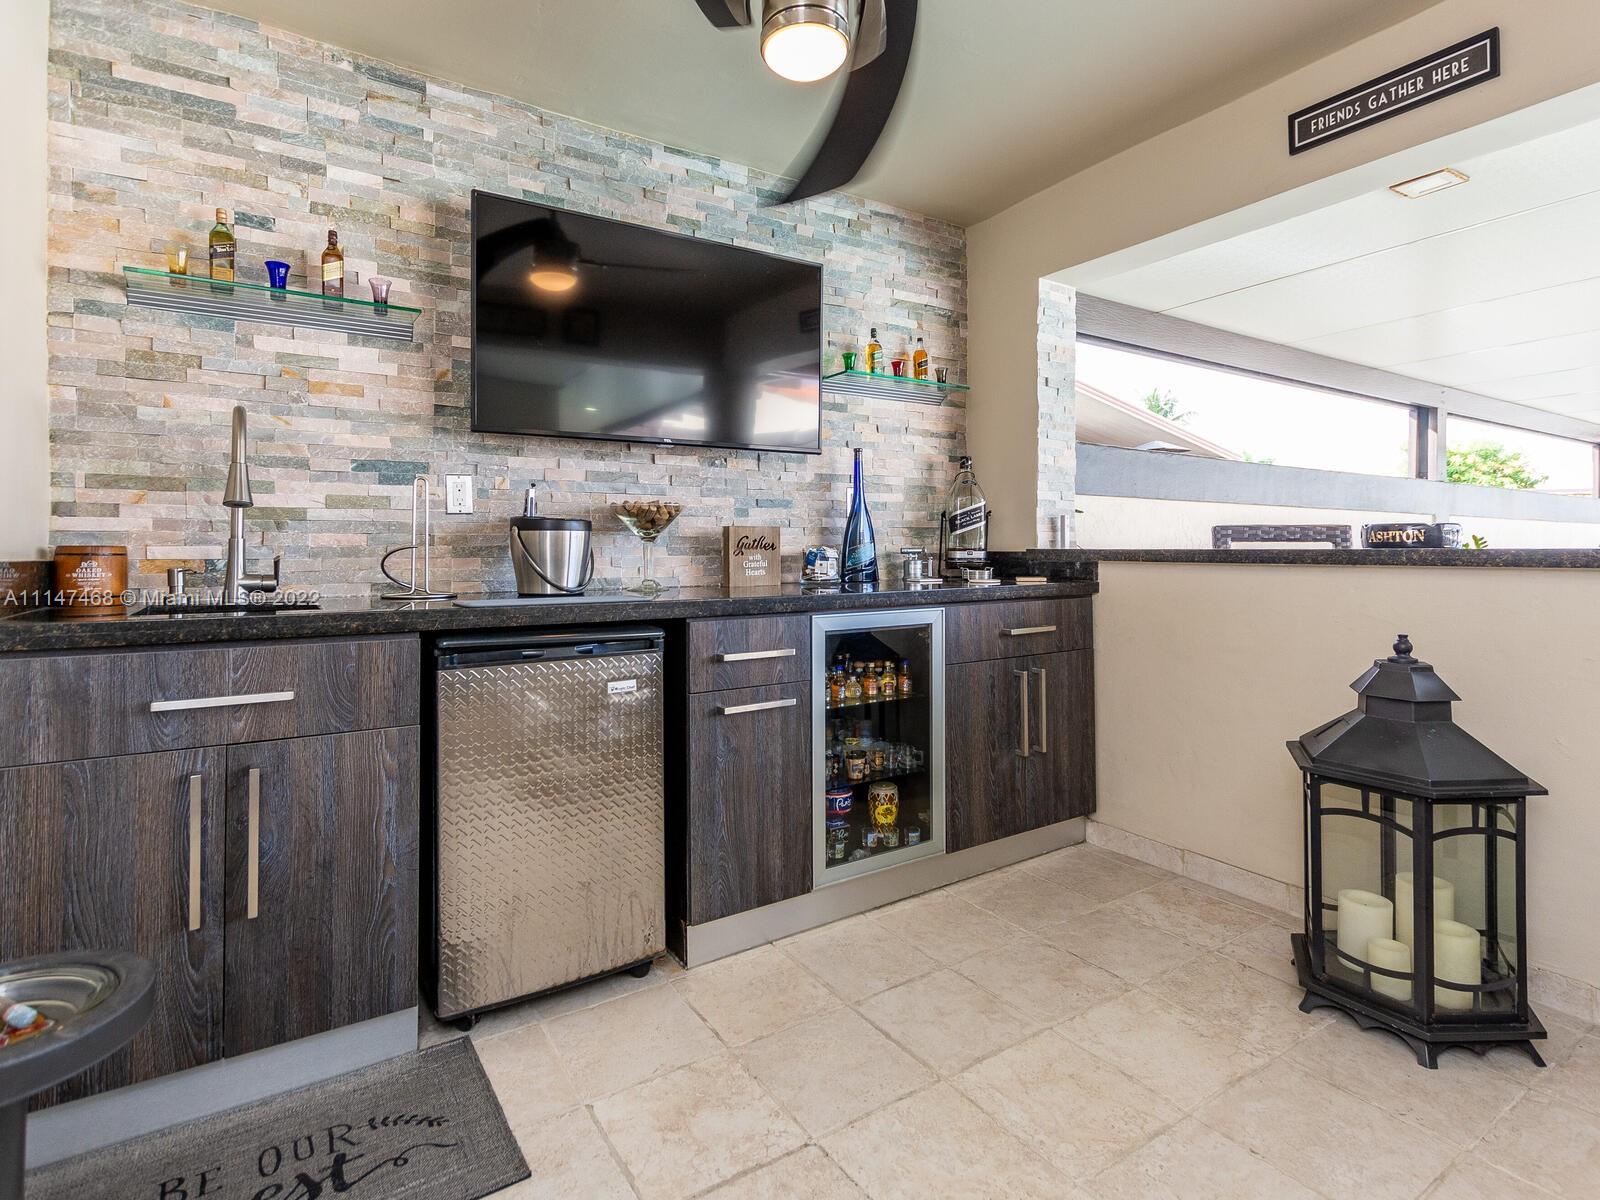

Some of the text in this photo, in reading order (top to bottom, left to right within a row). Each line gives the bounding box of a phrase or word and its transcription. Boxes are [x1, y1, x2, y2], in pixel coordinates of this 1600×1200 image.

[1310, 56, 1470, 133] FRIENDS GATHER HERE
[1368, 529, 1425, 543] ASHTON
[733, 535, 777, 557] Gather
[743, 560, 768, 568] Grateful
[748, 553, 762, 561] with
[745, 568, 766, 576] Hearts
[158, 1124, 362, 1200] BE OUR
